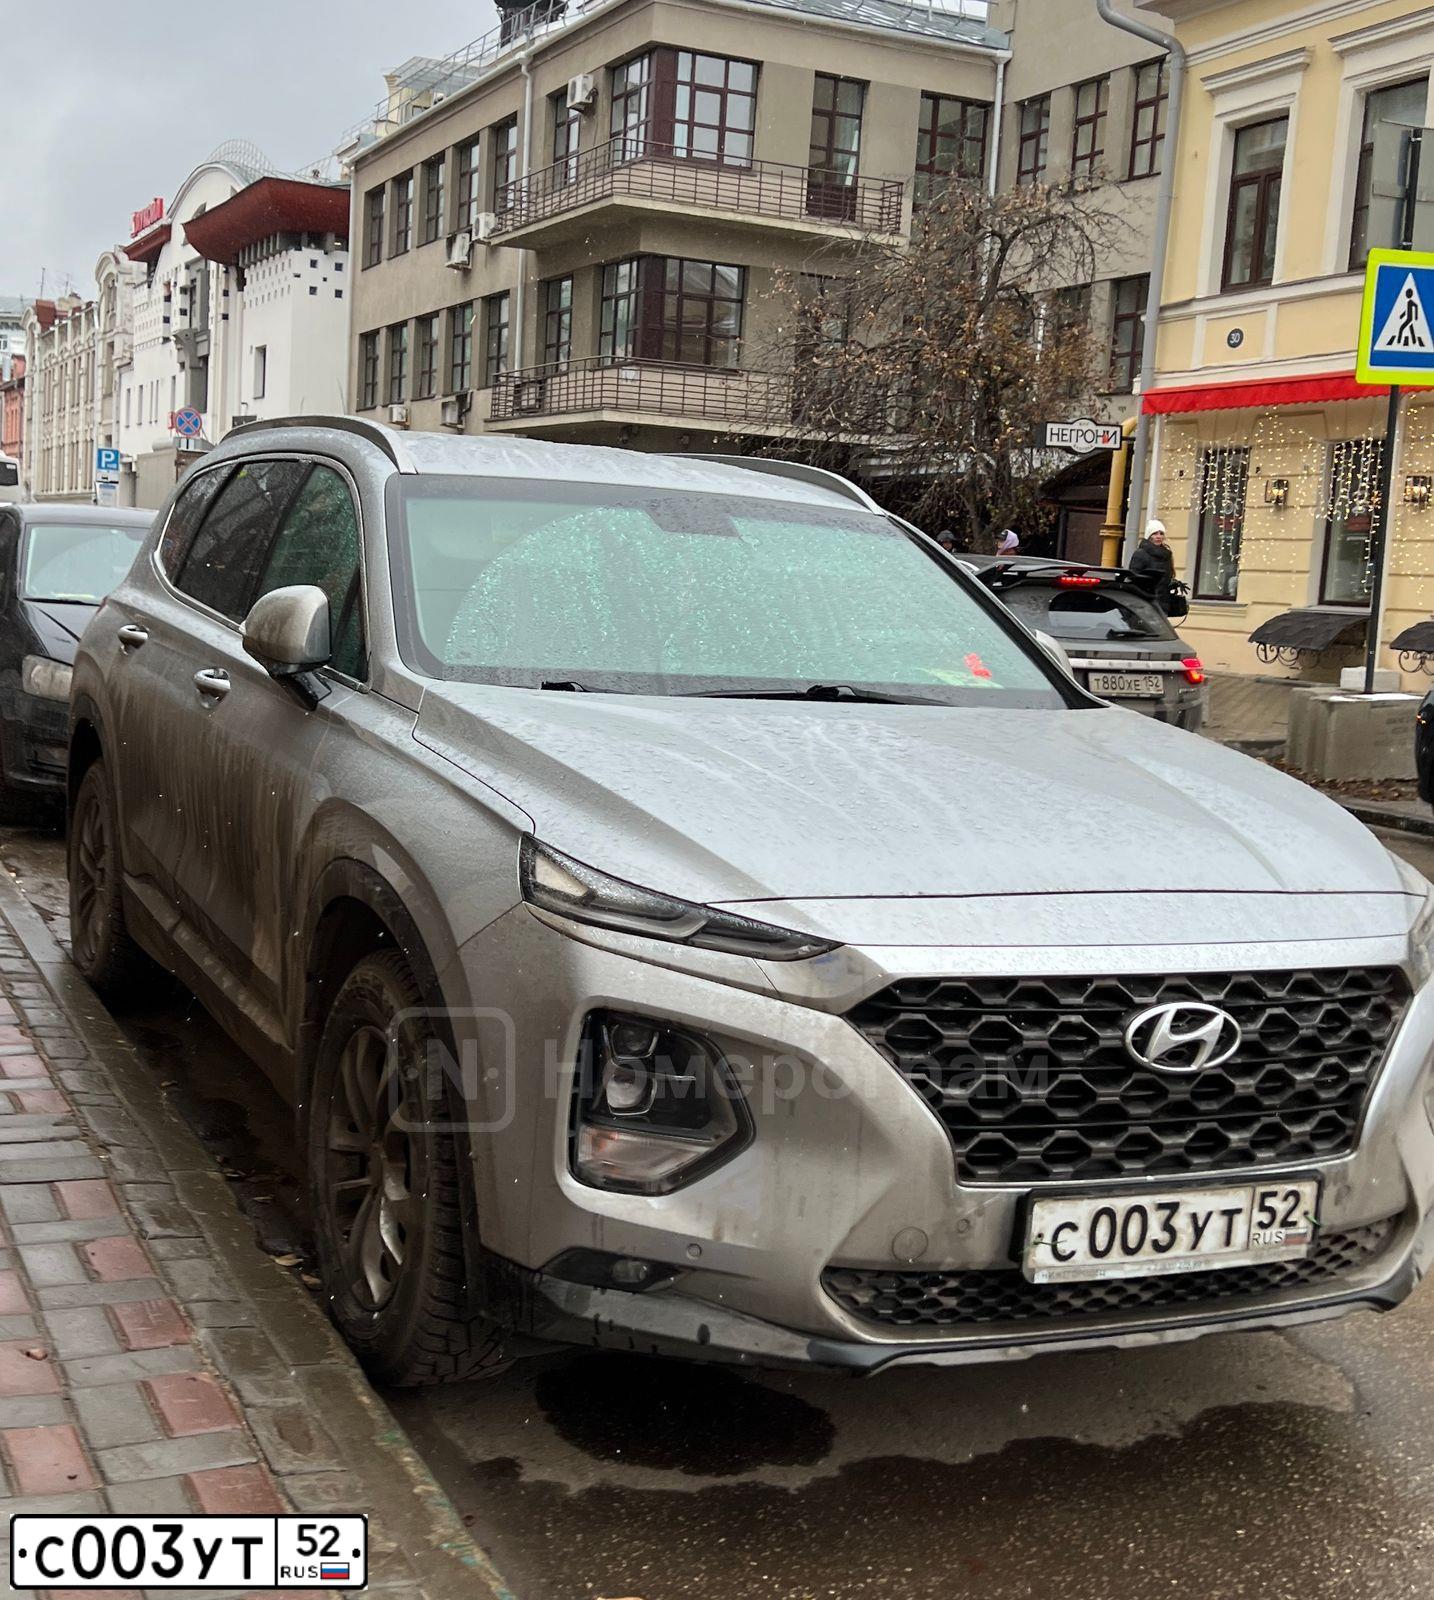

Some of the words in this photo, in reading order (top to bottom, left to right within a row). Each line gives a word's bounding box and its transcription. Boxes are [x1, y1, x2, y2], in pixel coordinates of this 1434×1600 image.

[1229, 332, 1241, 344] 30
[1050, 427, 1118, 445] НЕГРОНИ
[101, 450, 115, 468] P
[1143, 676, 1160, 688] 152
[1051, 1200, 1243, 1262] С003УТ
[1257, 1190, 1301, 1230] 52
[1252, 1231, 1284, 1246] RUS
